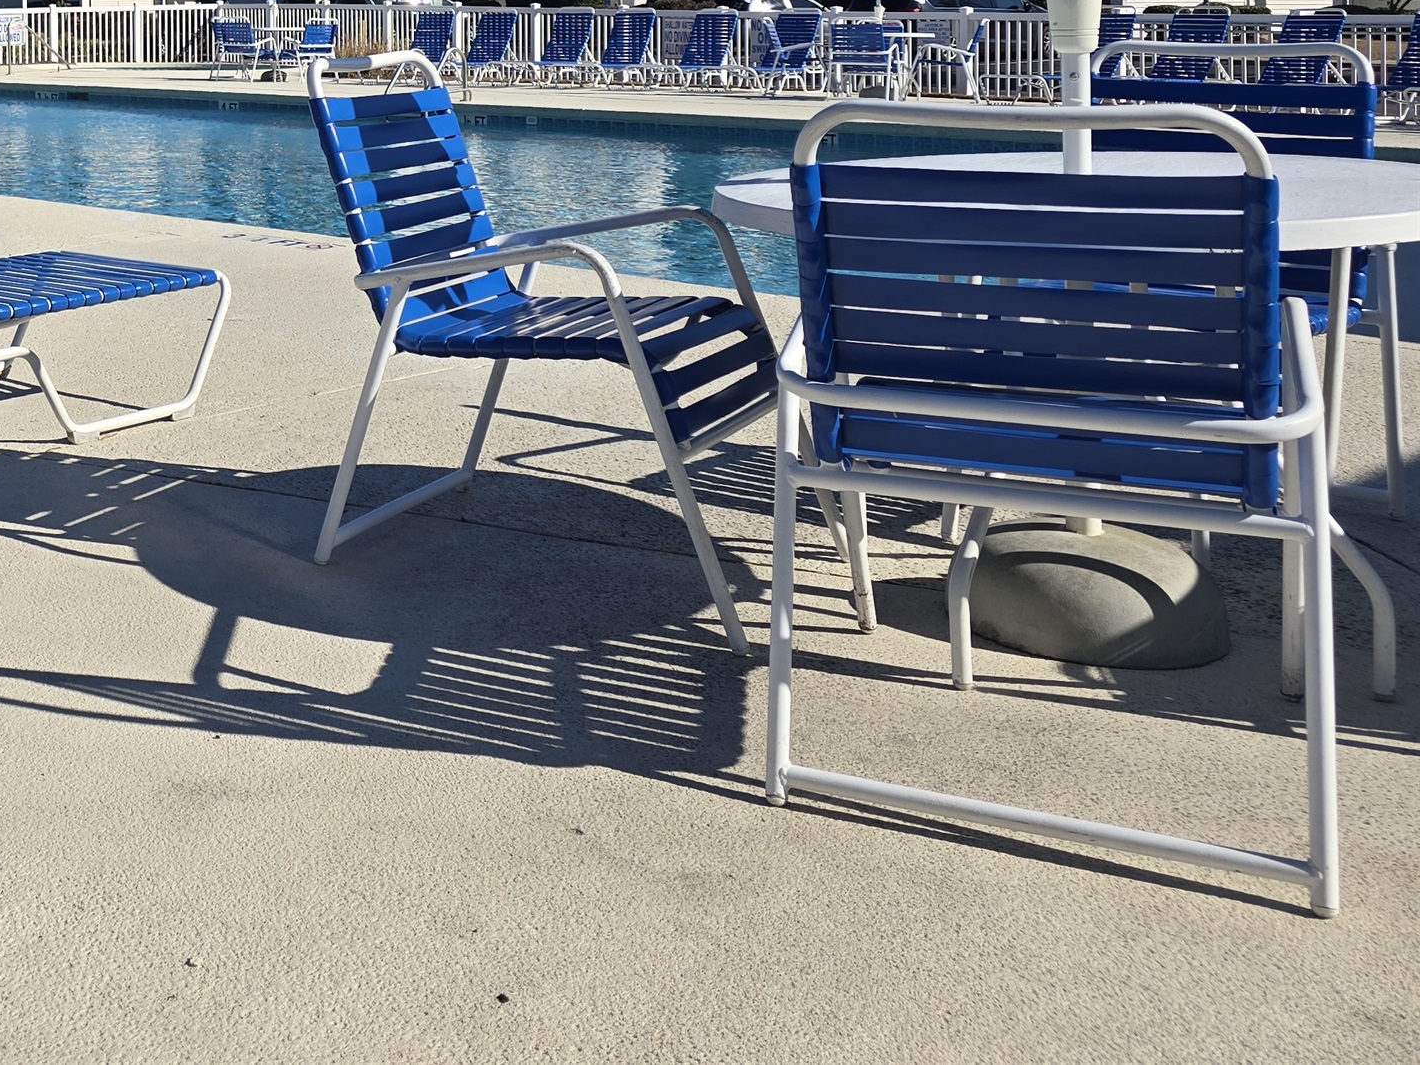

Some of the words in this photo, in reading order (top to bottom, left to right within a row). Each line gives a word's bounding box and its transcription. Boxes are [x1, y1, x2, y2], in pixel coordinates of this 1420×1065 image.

[665, 20, 681, 29] SHALLOW
[665, 31, 672, 42] NO
[674, 31, 690, 42] DIVIN
[474, 116, 486, 126] FT
